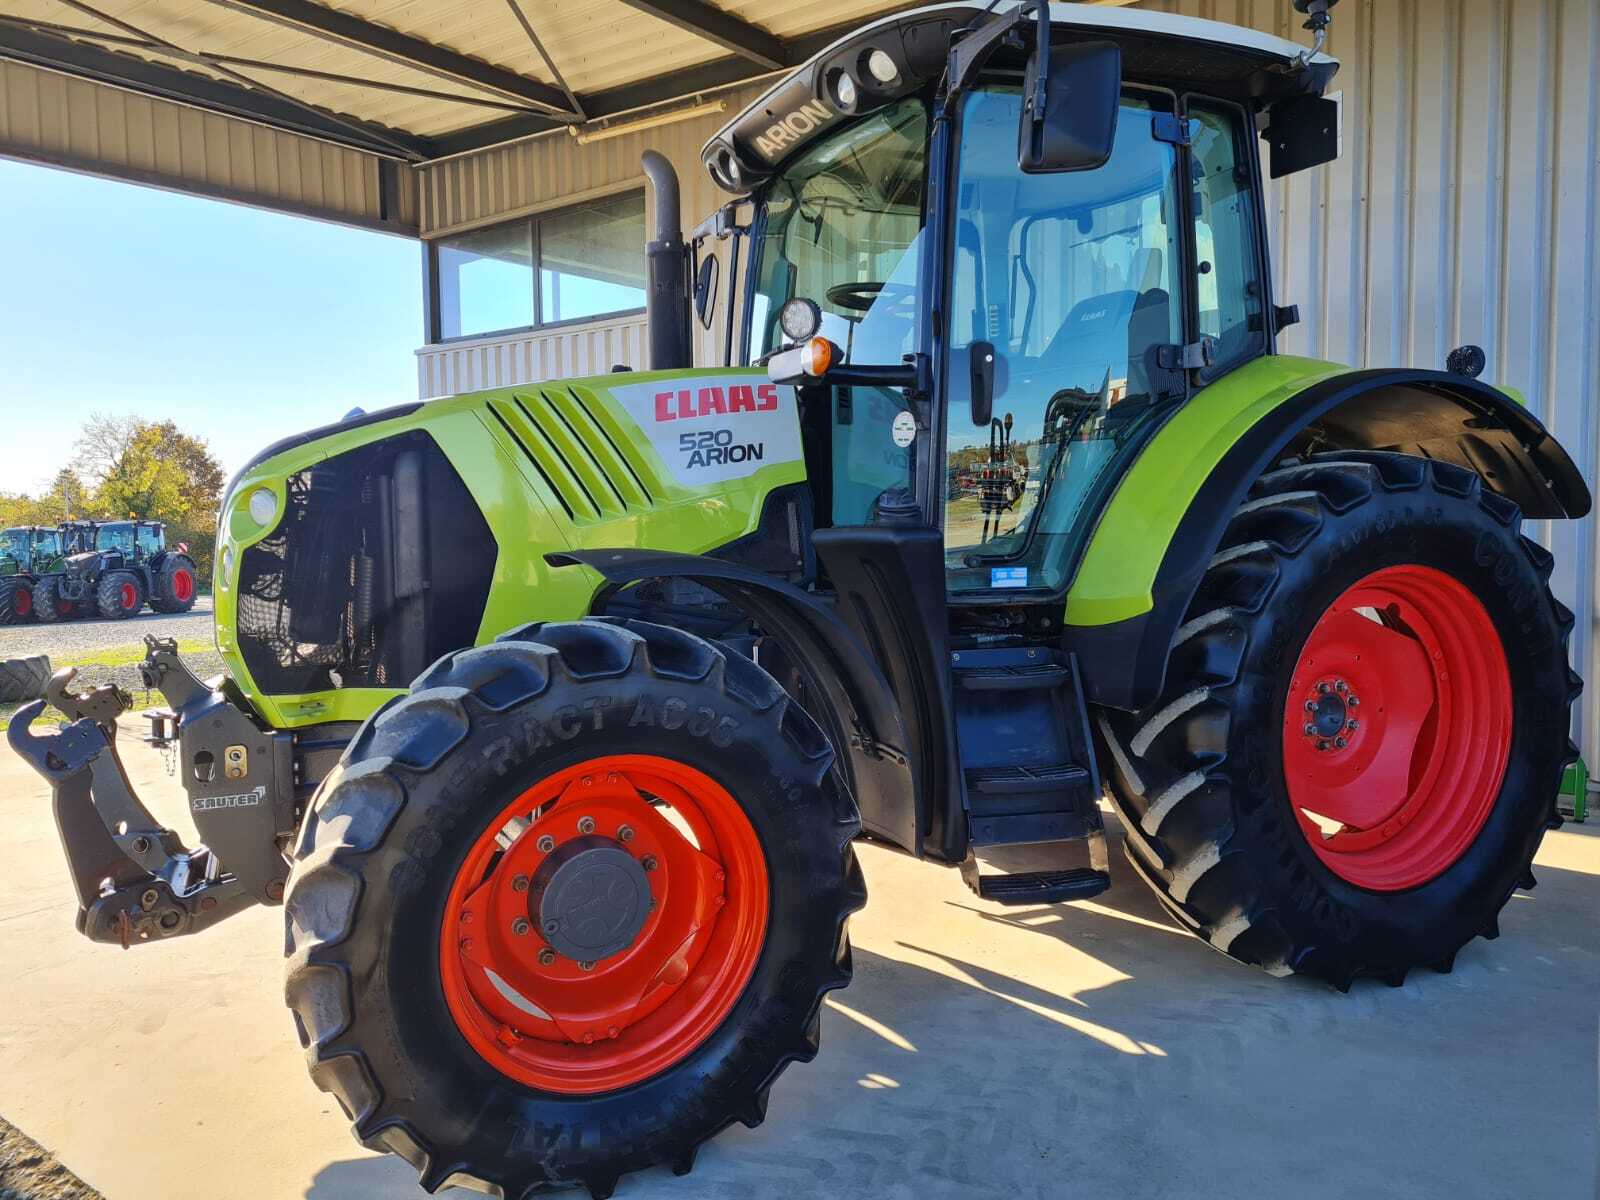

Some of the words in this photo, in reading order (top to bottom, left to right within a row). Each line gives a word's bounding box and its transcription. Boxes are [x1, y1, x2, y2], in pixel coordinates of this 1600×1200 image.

[756, 98, 833, 157] ARION
[654, 384, 778, 422] CLAAS
[679, 429, 733, 452] 520
[686, 442, 764, 469] ARION
[193, 793, 259, 811] SAUTER
